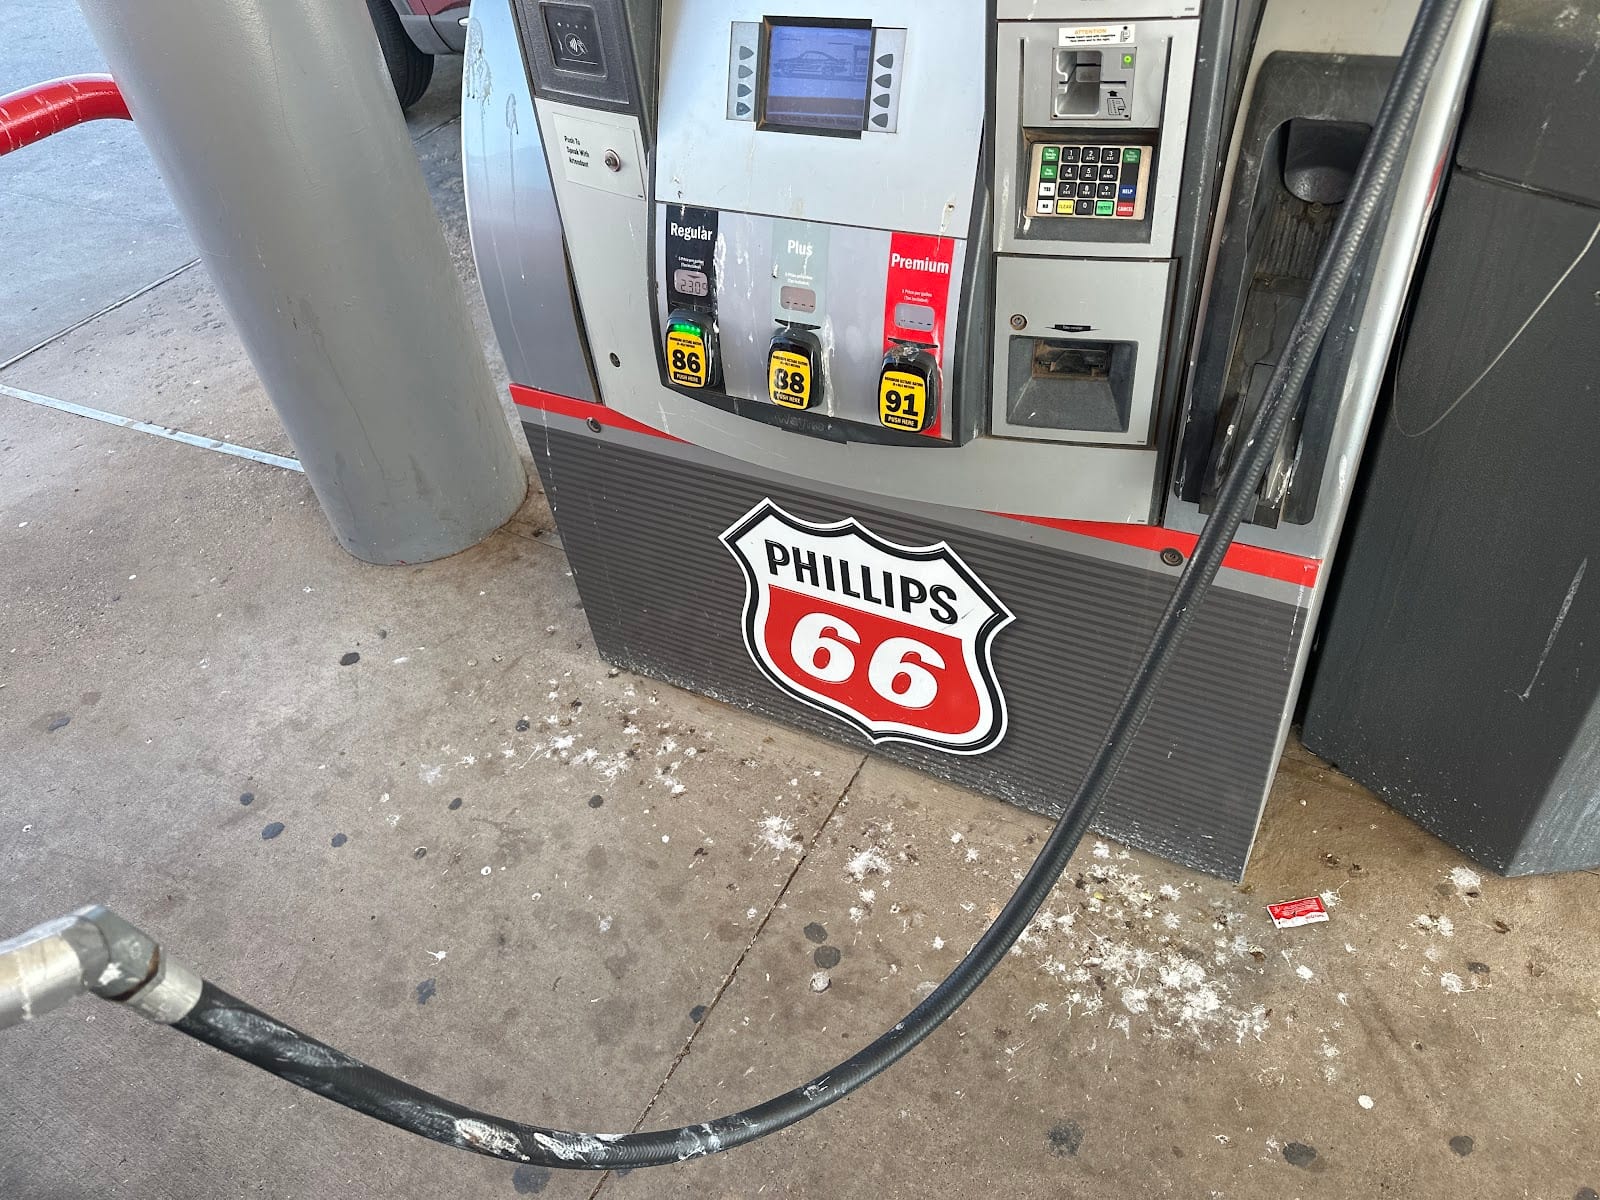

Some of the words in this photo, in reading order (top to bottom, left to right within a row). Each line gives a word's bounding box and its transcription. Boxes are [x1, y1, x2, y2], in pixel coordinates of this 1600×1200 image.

[670, 222, 712, 240] Regular
[788, 240, 812, 256] Plus
[891, 252, 950, 274] Premium
[672, 349, 700, 373] 86
[774, 368, 804, 394] 88
[886, 390, 918, 416] 91
[764, 539, 958, 624] PHILLIPS
[790, 612, 946, 710] 66
